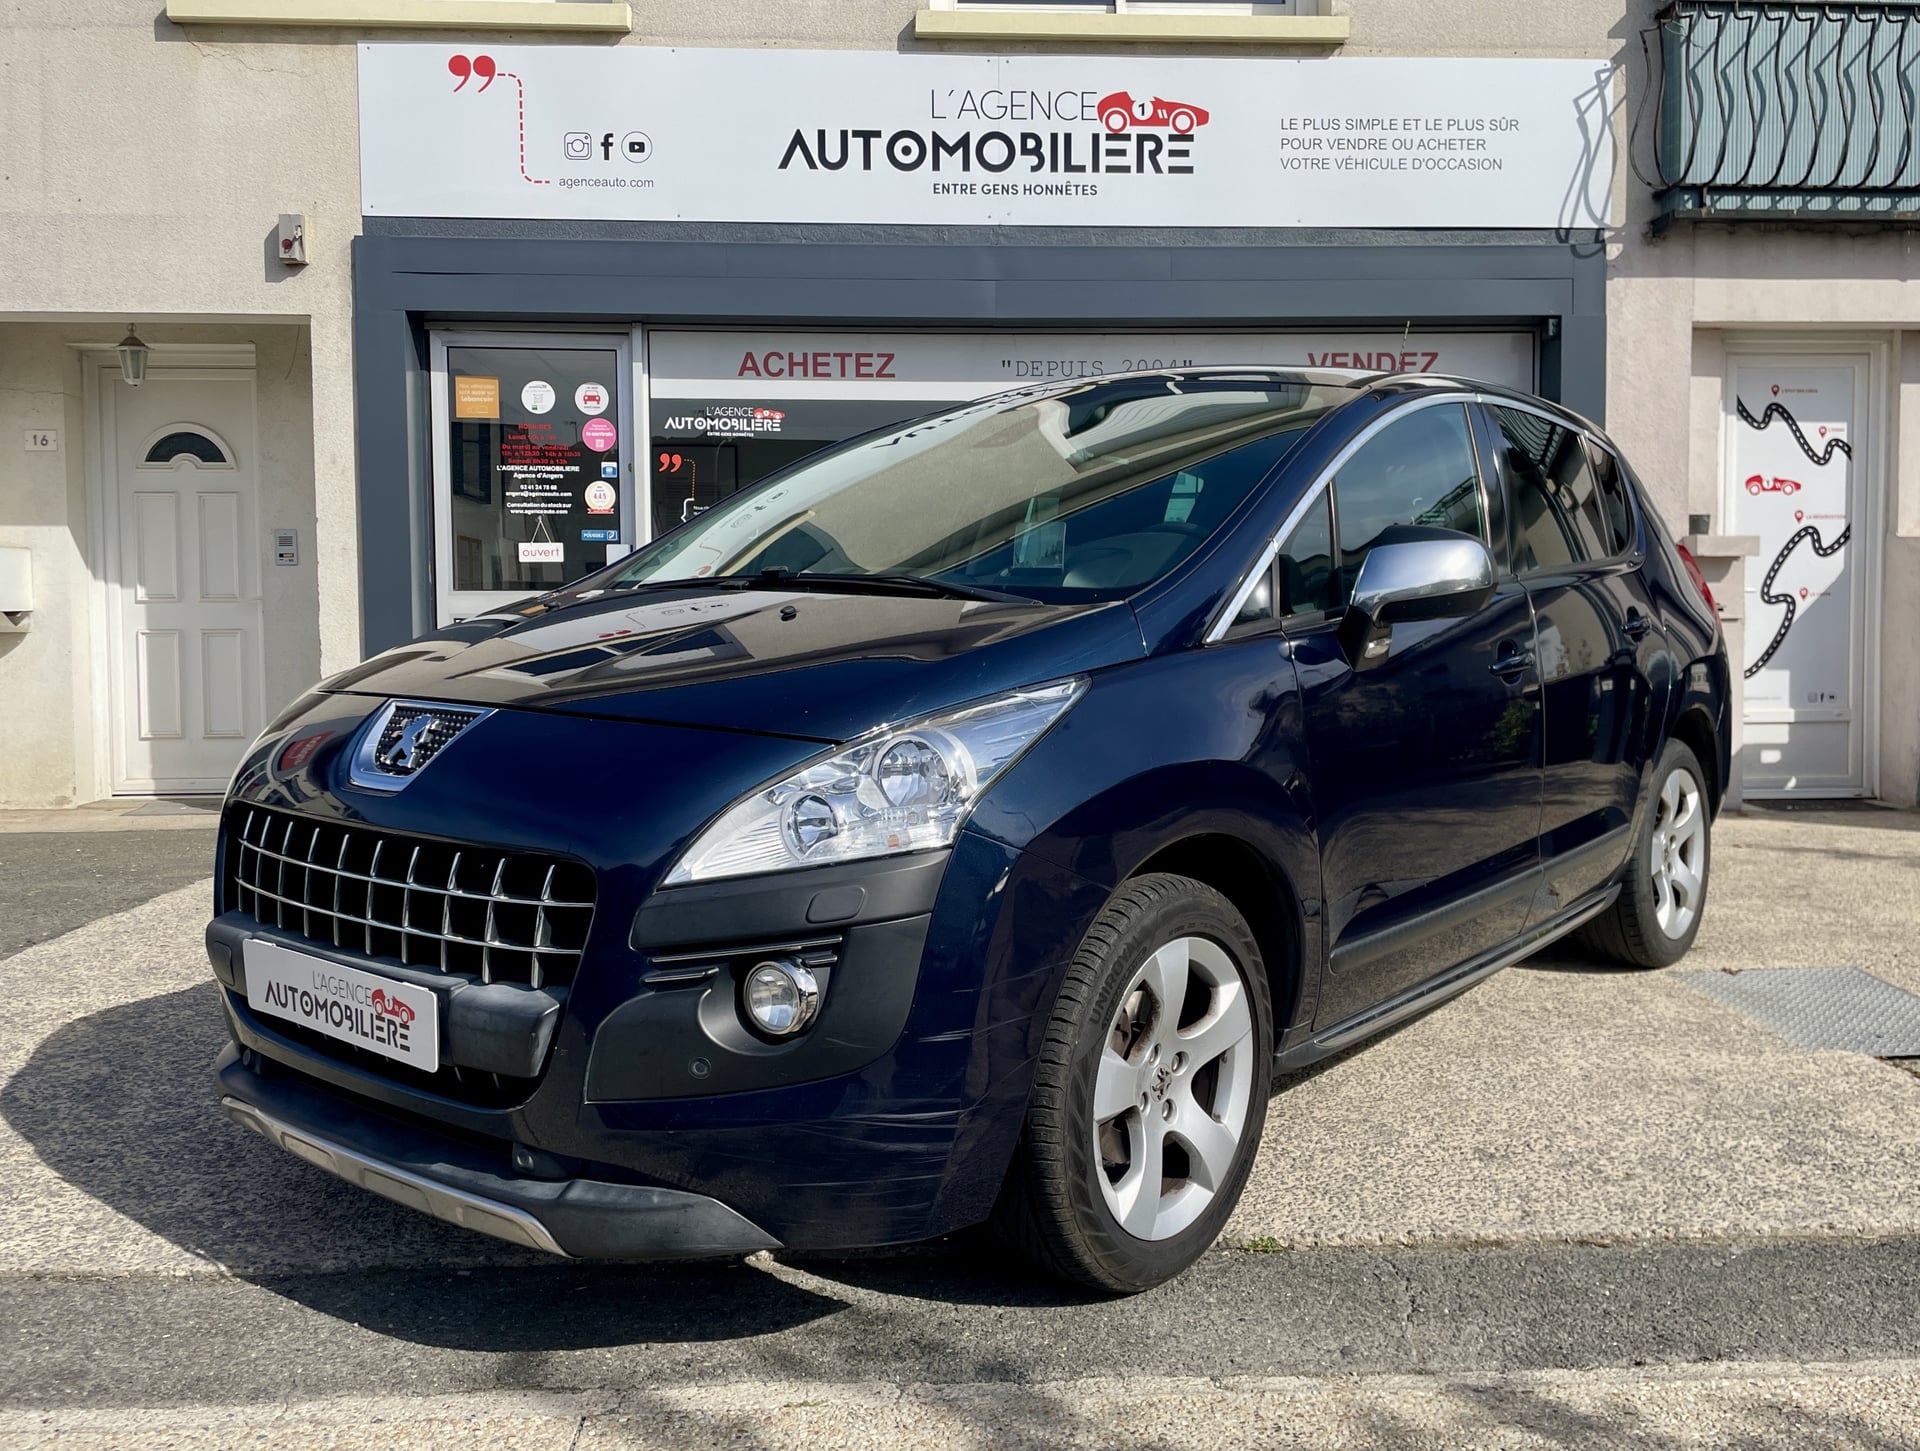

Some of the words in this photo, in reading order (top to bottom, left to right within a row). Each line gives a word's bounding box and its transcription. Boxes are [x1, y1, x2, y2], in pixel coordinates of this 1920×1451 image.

[931, 89, 1098, 121] L'AGENCE
[1281, 118, 1298, 130] LE
[1303, 118, 1341, 130] PLUS
[1345, 118, 1398, 131] SIMPLE
[1403, 119, 1421, 131] ET
[1425, 119, 1442, 131] LE
[1448, 119, 1485, 131] PLUS
[1489, 117, 1520, 131] SÛR
[1281, 138, 1323, 150] POUR
[1327, 138, 1387, 151] VENDRE
[1392, 138, 1413, 150] OU
[1417, 138, 1486, 151] ACHETER
[1280, 158, 1330, 170] VOTRE
[1335, 155, 1407, 170] VÉHICULE
[1412, 158, 1502, 170] D'OCCASION
[559, 177, 654, 189] agenceauto.com
[933, 183, 977, 195] ENTRE
[981, 183, 1019, 196] GENS
[1023, 180, 1098, 196] HONNÊTES
[738, 351, 896, 378] ACHETEZ
[1307, 352, 1439, 373] VENDEZ
[706, 406, 754, 417] L'AGENCE
[33, 434, 48, 446] 16
[522, 548, 560, 557] ouvert
[313, 970, 373, 1008] L'AGENCE
